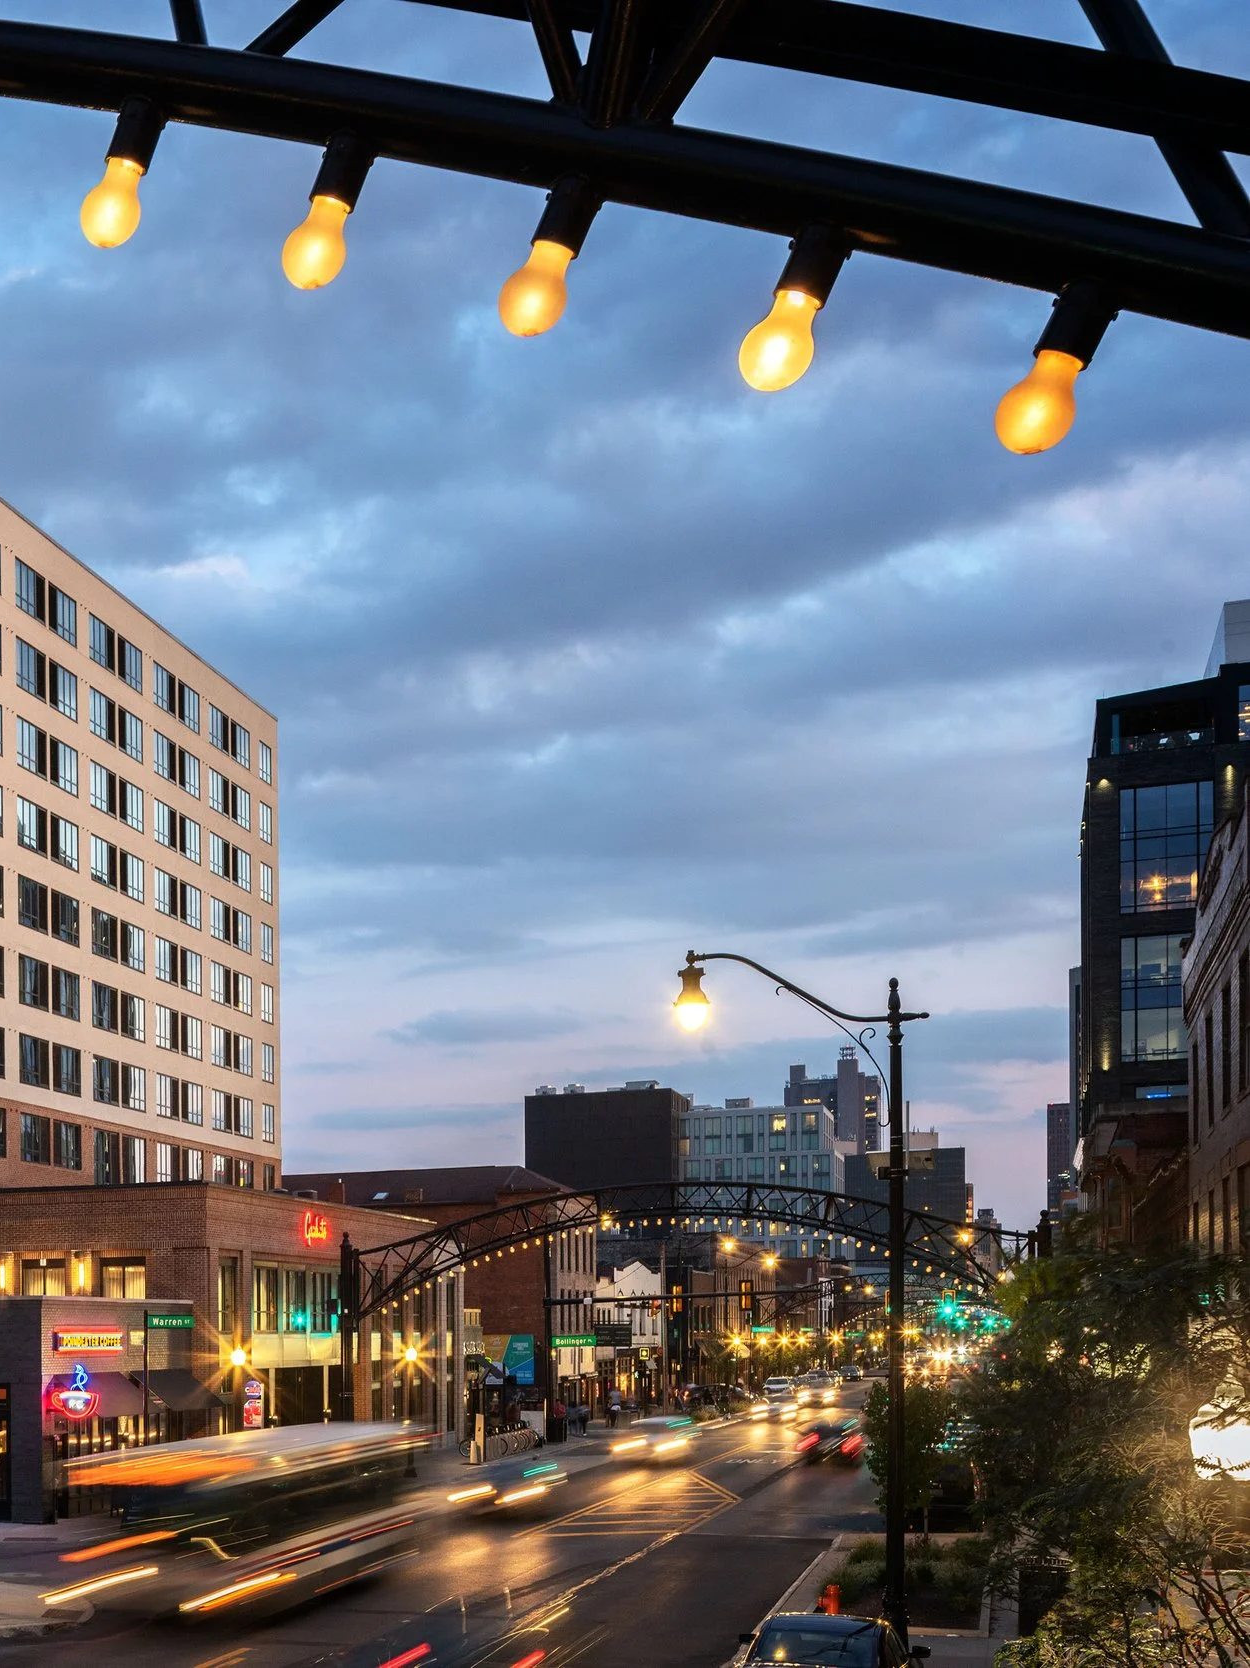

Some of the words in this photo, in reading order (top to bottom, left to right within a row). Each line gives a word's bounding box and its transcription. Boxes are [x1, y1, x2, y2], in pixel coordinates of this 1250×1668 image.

[152, 1317, 183, 1326] Warren
[100, 1336, 121, 1347] COFFEE
[555, 1338, 587, 1346] Bollinger
